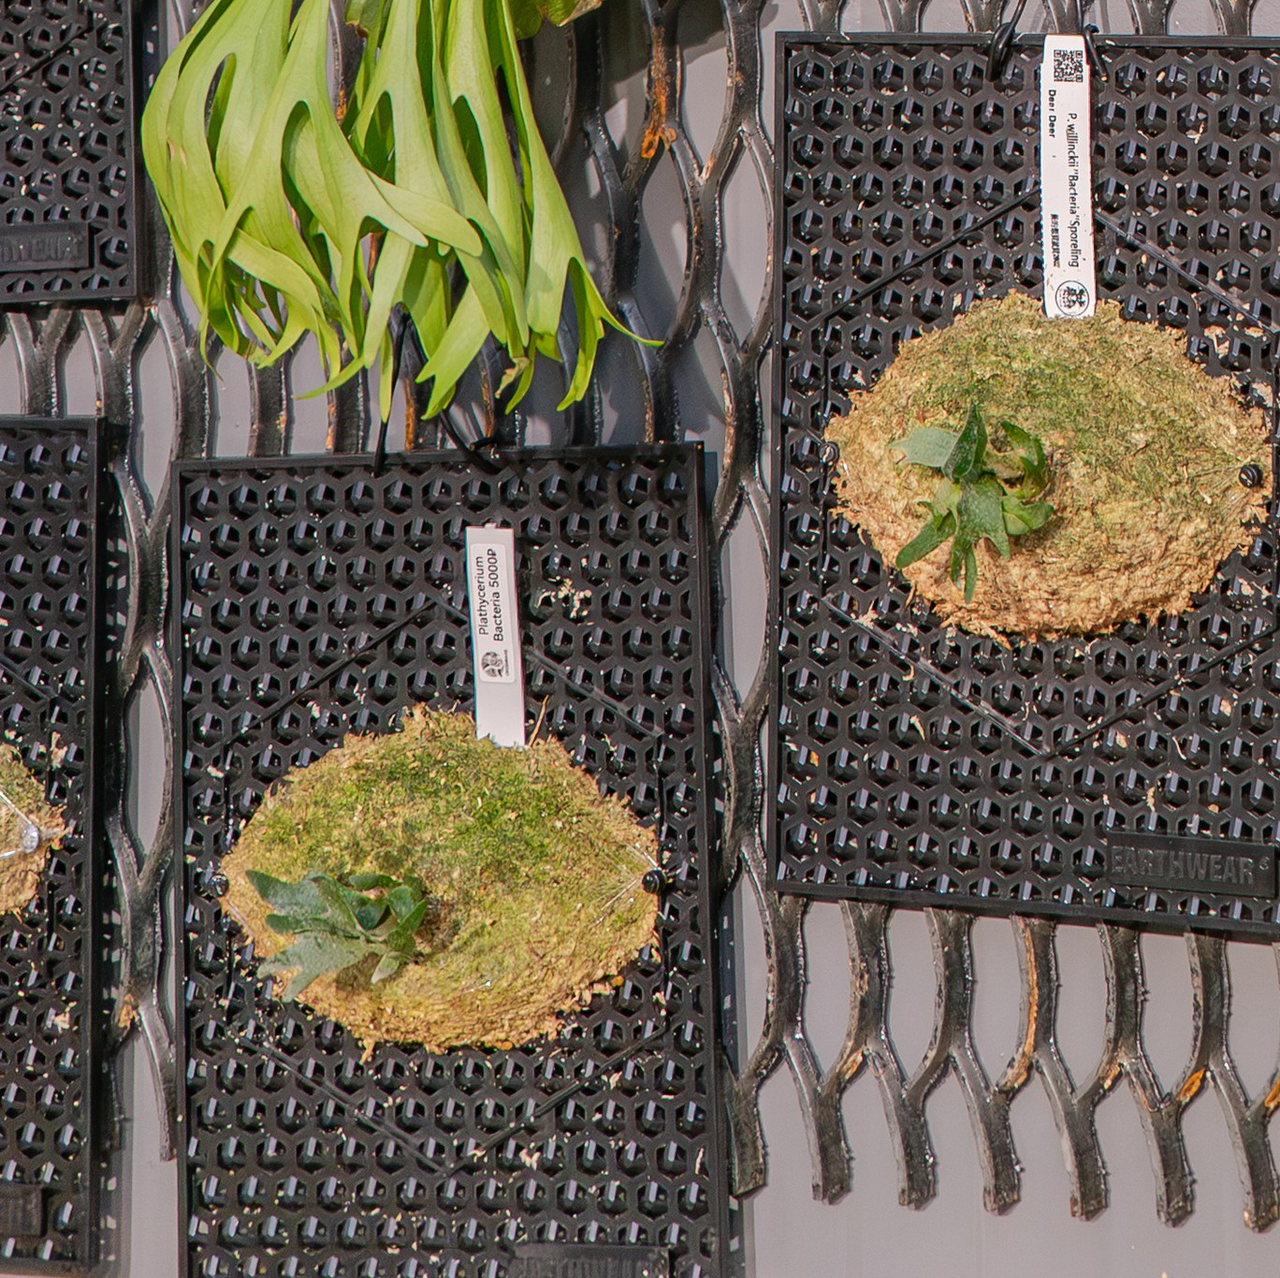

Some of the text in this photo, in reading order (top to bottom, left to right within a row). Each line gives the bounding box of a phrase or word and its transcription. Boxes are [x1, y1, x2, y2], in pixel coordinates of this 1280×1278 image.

[1049, 115, 1057, 138] Deer
[1067, 124, 1079, 167] willinckii
[474, 556, 489, 635] Plathycerium
[491, 591, 504, 642] Bacteria
[1111, 845, 1254, 884] EARTHWEAR
